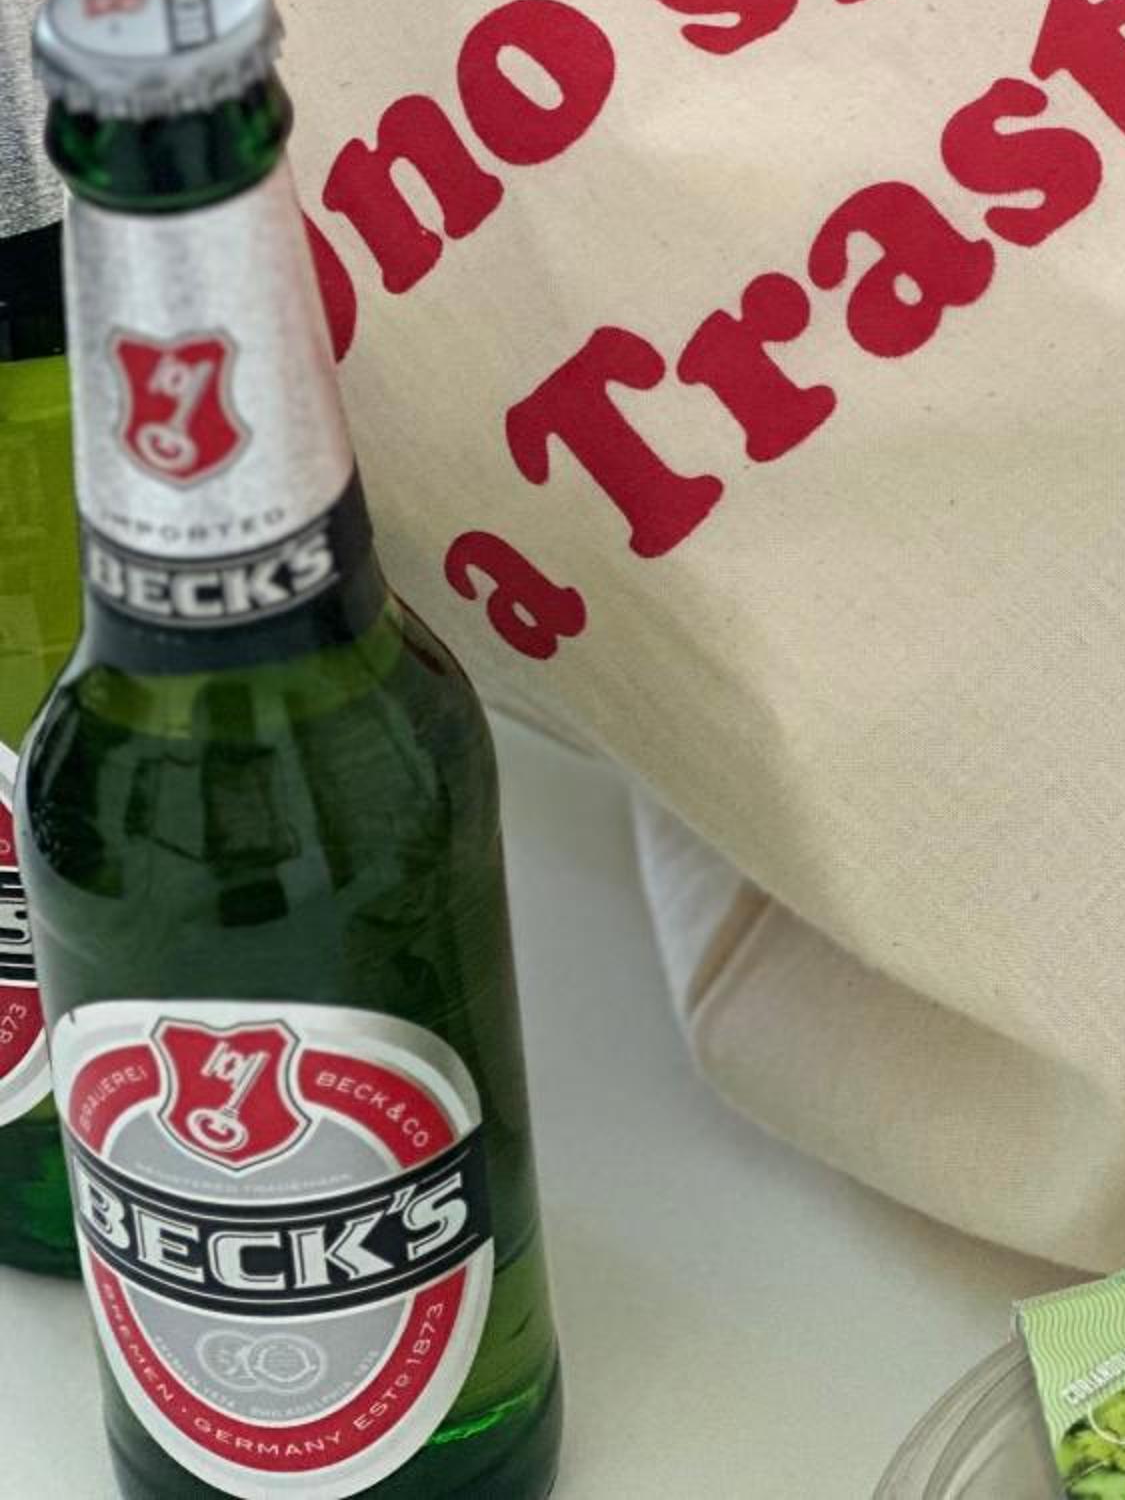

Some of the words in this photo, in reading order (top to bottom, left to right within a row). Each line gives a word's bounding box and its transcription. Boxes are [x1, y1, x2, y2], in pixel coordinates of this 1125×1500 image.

[88, 530, 334, 619] BECK'S
[443, 530, 587, 661] a
[77, 1168, 469, 1291] BECK'S
[193, 1416, 342, 1458] GERMANY
[406, 1302, 445, 1364] 1873
